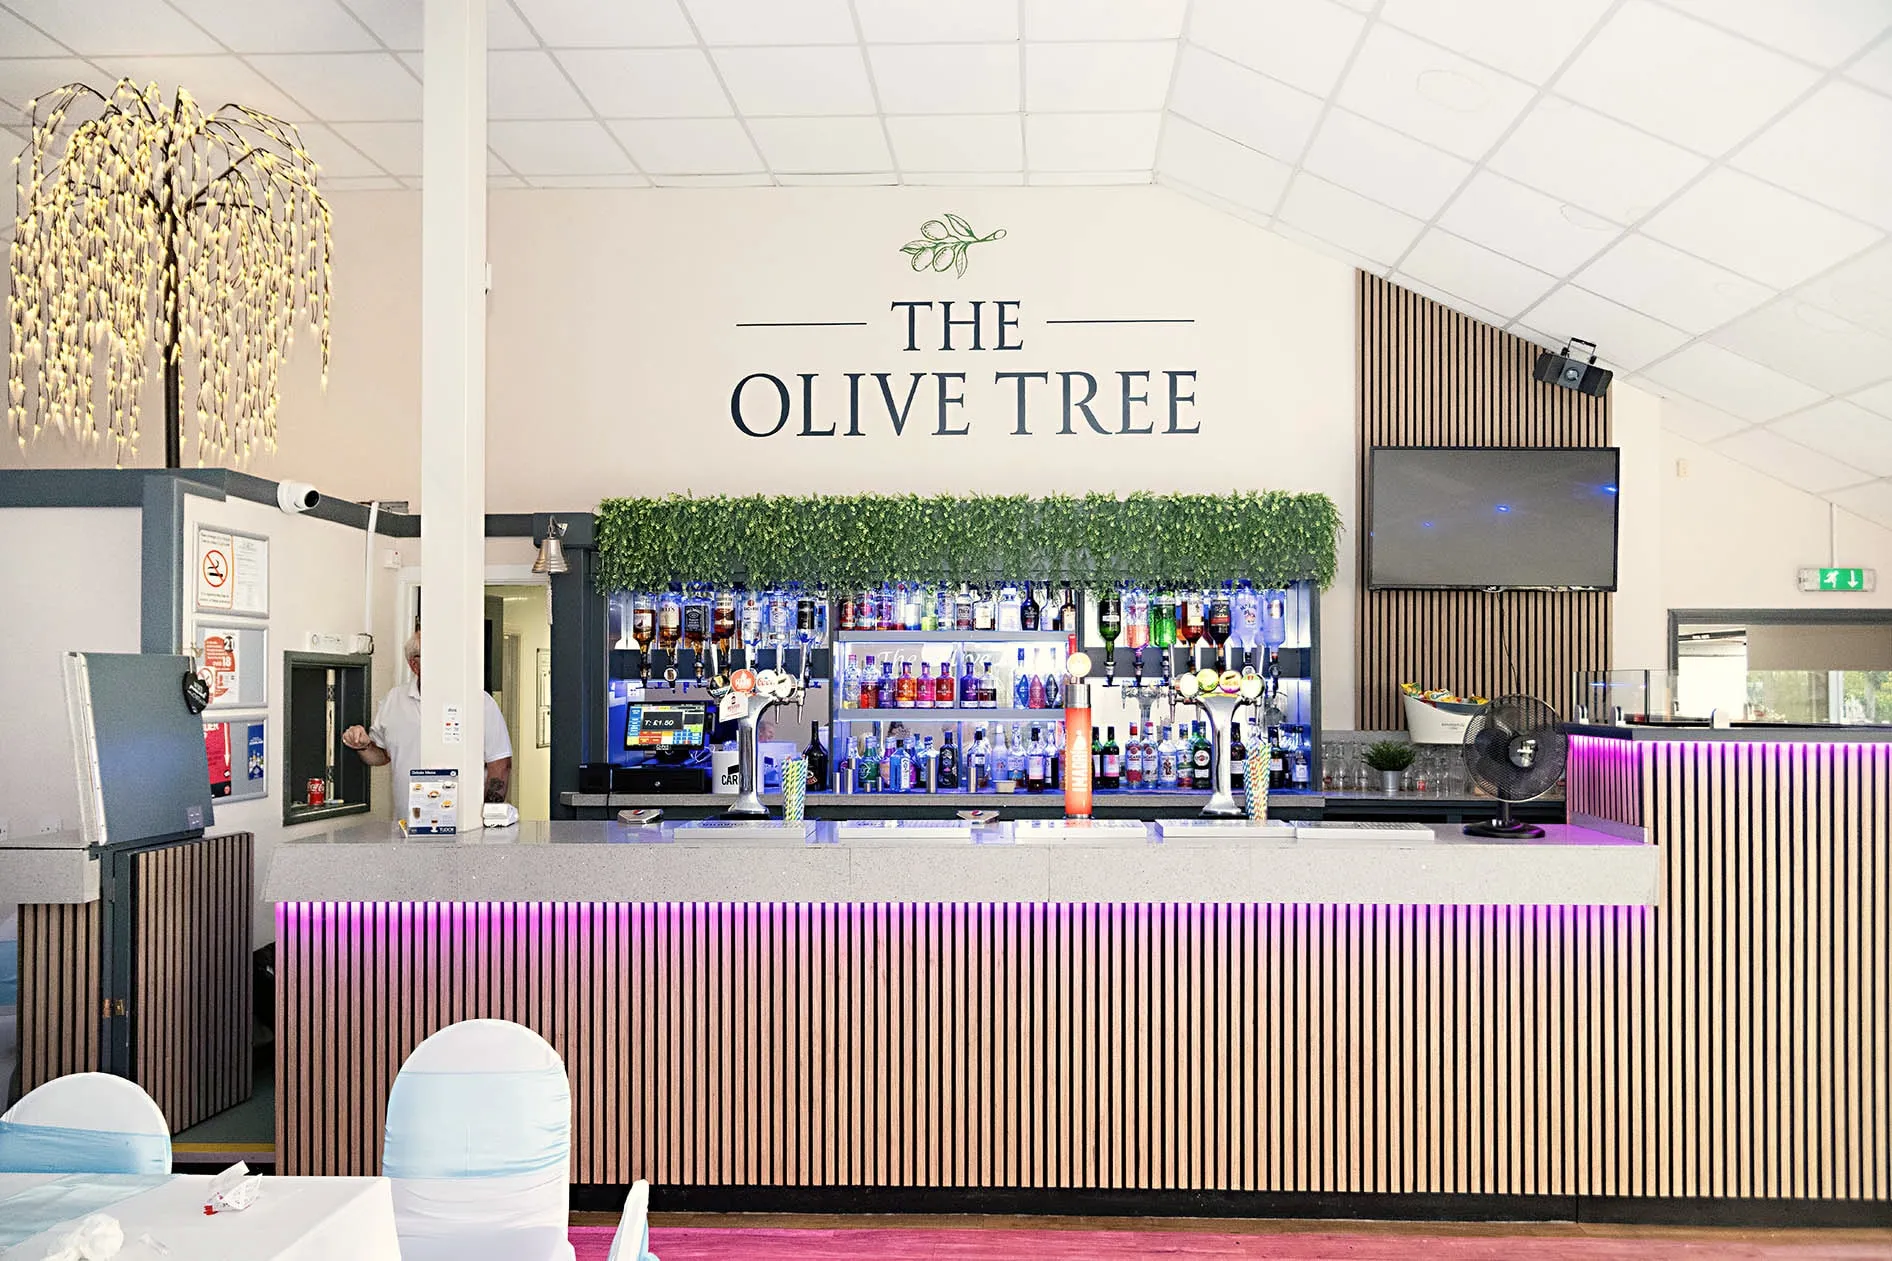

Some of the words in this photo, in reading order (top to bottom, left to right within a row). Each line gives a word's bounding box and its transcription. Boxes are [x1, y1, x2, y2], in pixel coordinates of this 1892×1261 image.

[890, 300, 1024, 352] THE
[730, 372, 971, 437] OLIVE
[995, 369, 1202, 436] TREE
[224, 638, 234, 651] 21
[222, 656, 232, 667] 18
